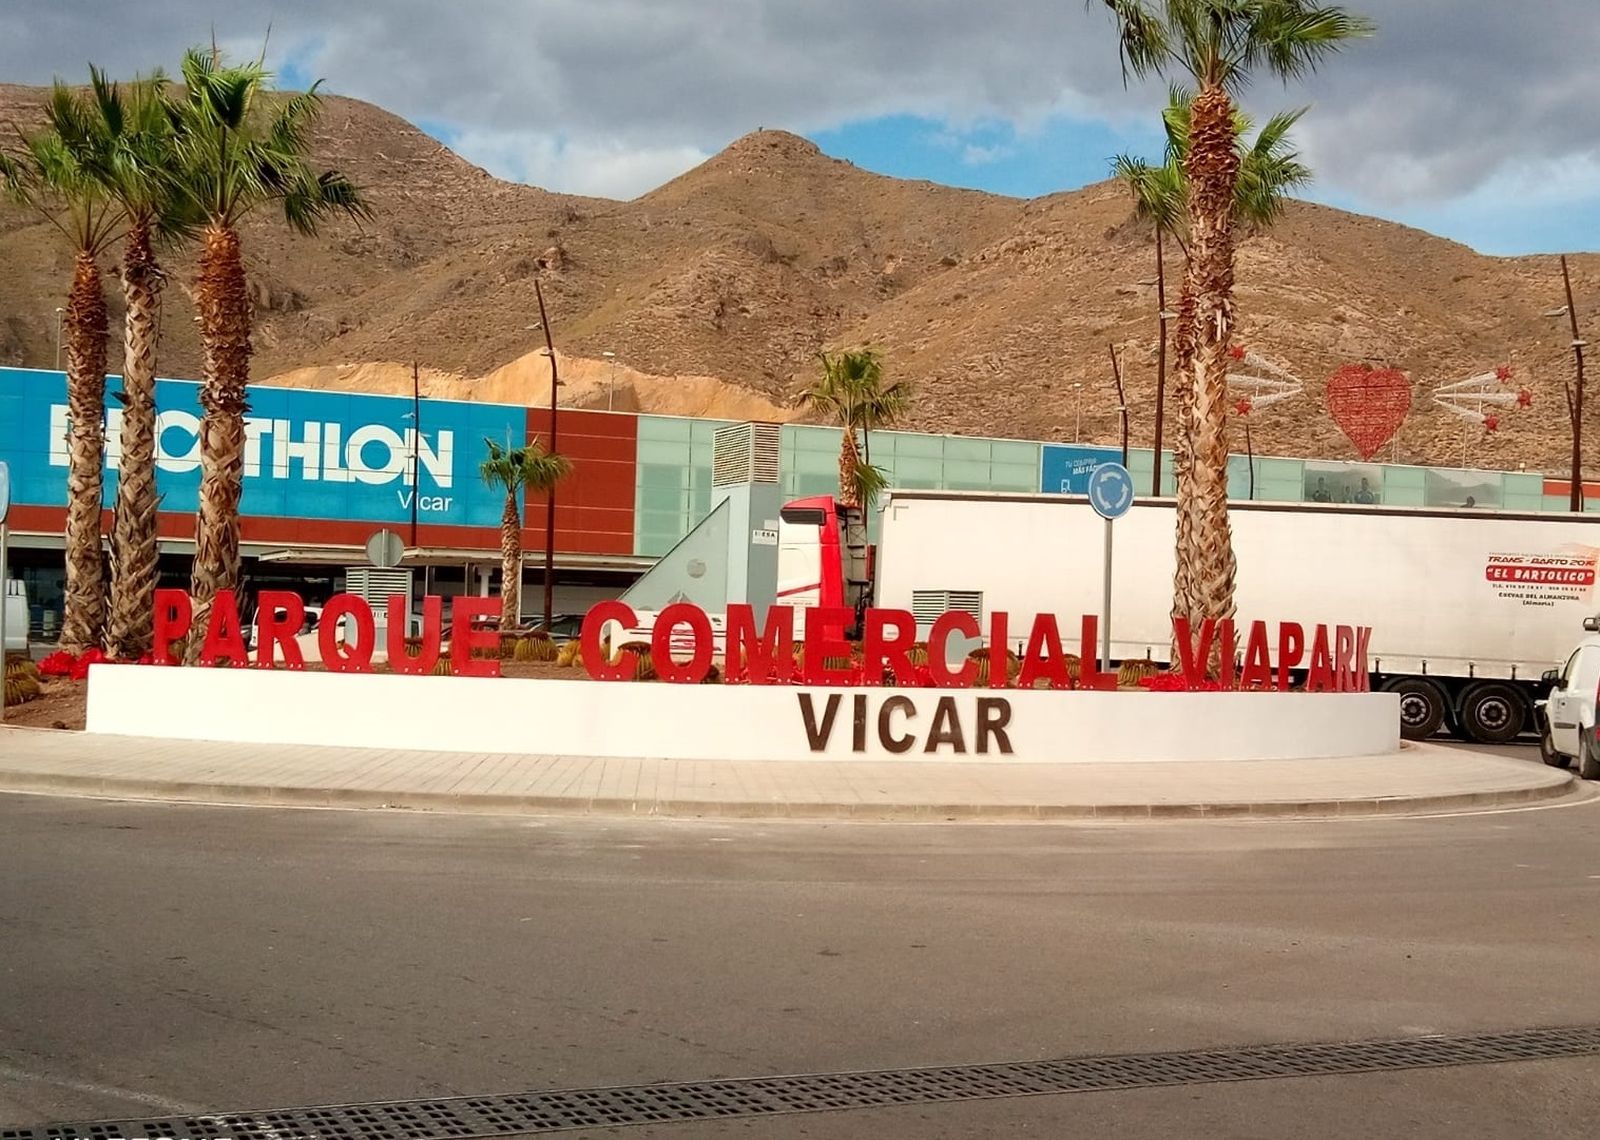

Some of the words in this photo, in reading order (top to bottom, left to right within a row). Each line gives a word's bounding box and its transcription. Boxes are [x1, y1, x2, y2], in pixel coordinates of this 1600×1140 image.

[153, 588, 502, 678] PARQUE
[581, 600, 1118, 691] COMERCIAL
[1173, 615, 1373, 693] VIAPARK
[797, 692, 1014, 756] VICAR
